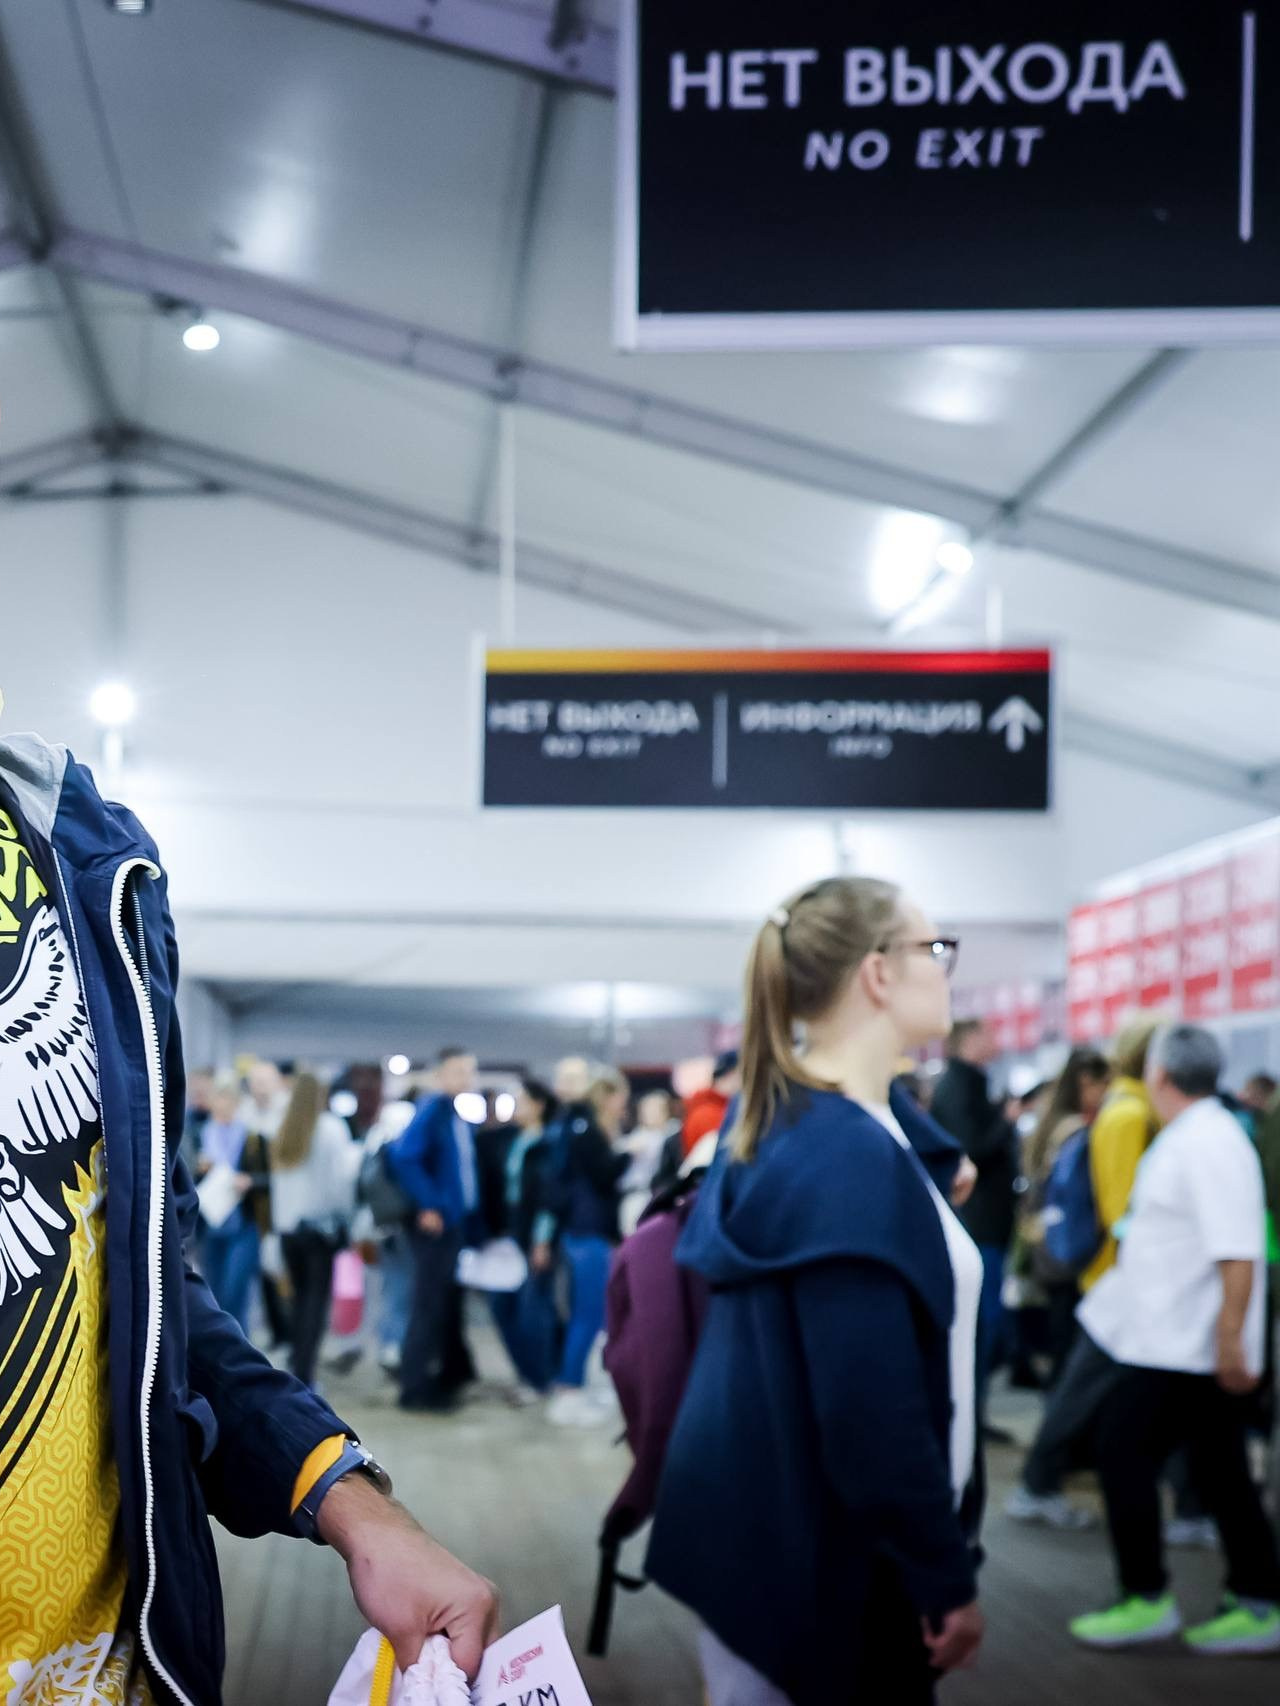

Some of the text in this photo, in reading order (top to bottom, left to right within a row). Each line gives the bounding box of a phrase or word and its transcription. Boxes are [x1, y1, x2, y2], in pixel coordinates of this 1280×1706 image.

[670, 40, 1187, 115] НЕТ ВЫХОДА
[804, 126, 1045, 171] NO EXIT
[489, 700, 700, 737] НЕТ ВЫХОДА
[739, 700, 982, 737] ИНФОРМАЦИЯ
